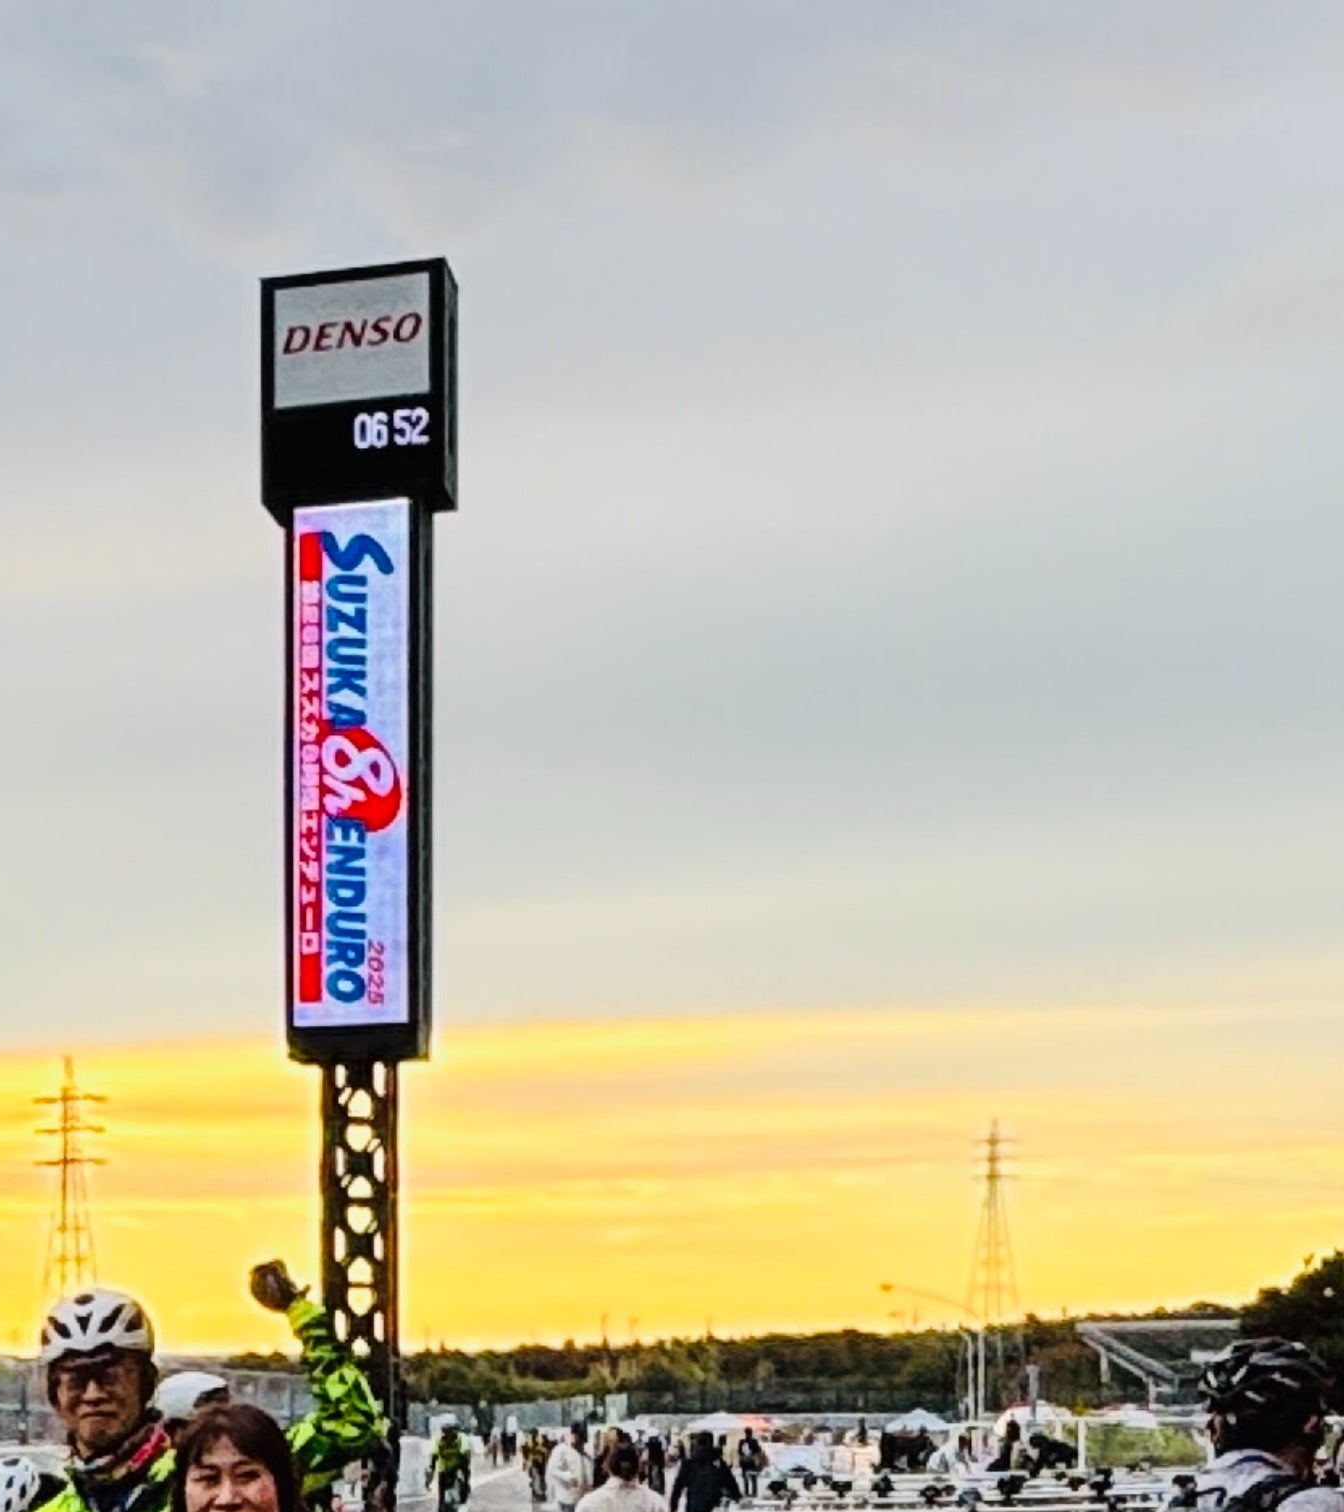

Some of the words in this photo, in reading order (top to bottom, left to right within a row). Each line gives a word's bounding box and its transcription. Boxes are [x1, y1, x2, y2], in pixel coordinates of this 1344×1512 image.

[282, 311, 422, 355] DENSO
[353, 412, 389, 450] 06
[393, 406, 430, 446] 52
[322, 531, 396, 730] SUZUKA
[326, 816, 369, 1004] ENDURO
[368, 938, 385, 1005] 2025
